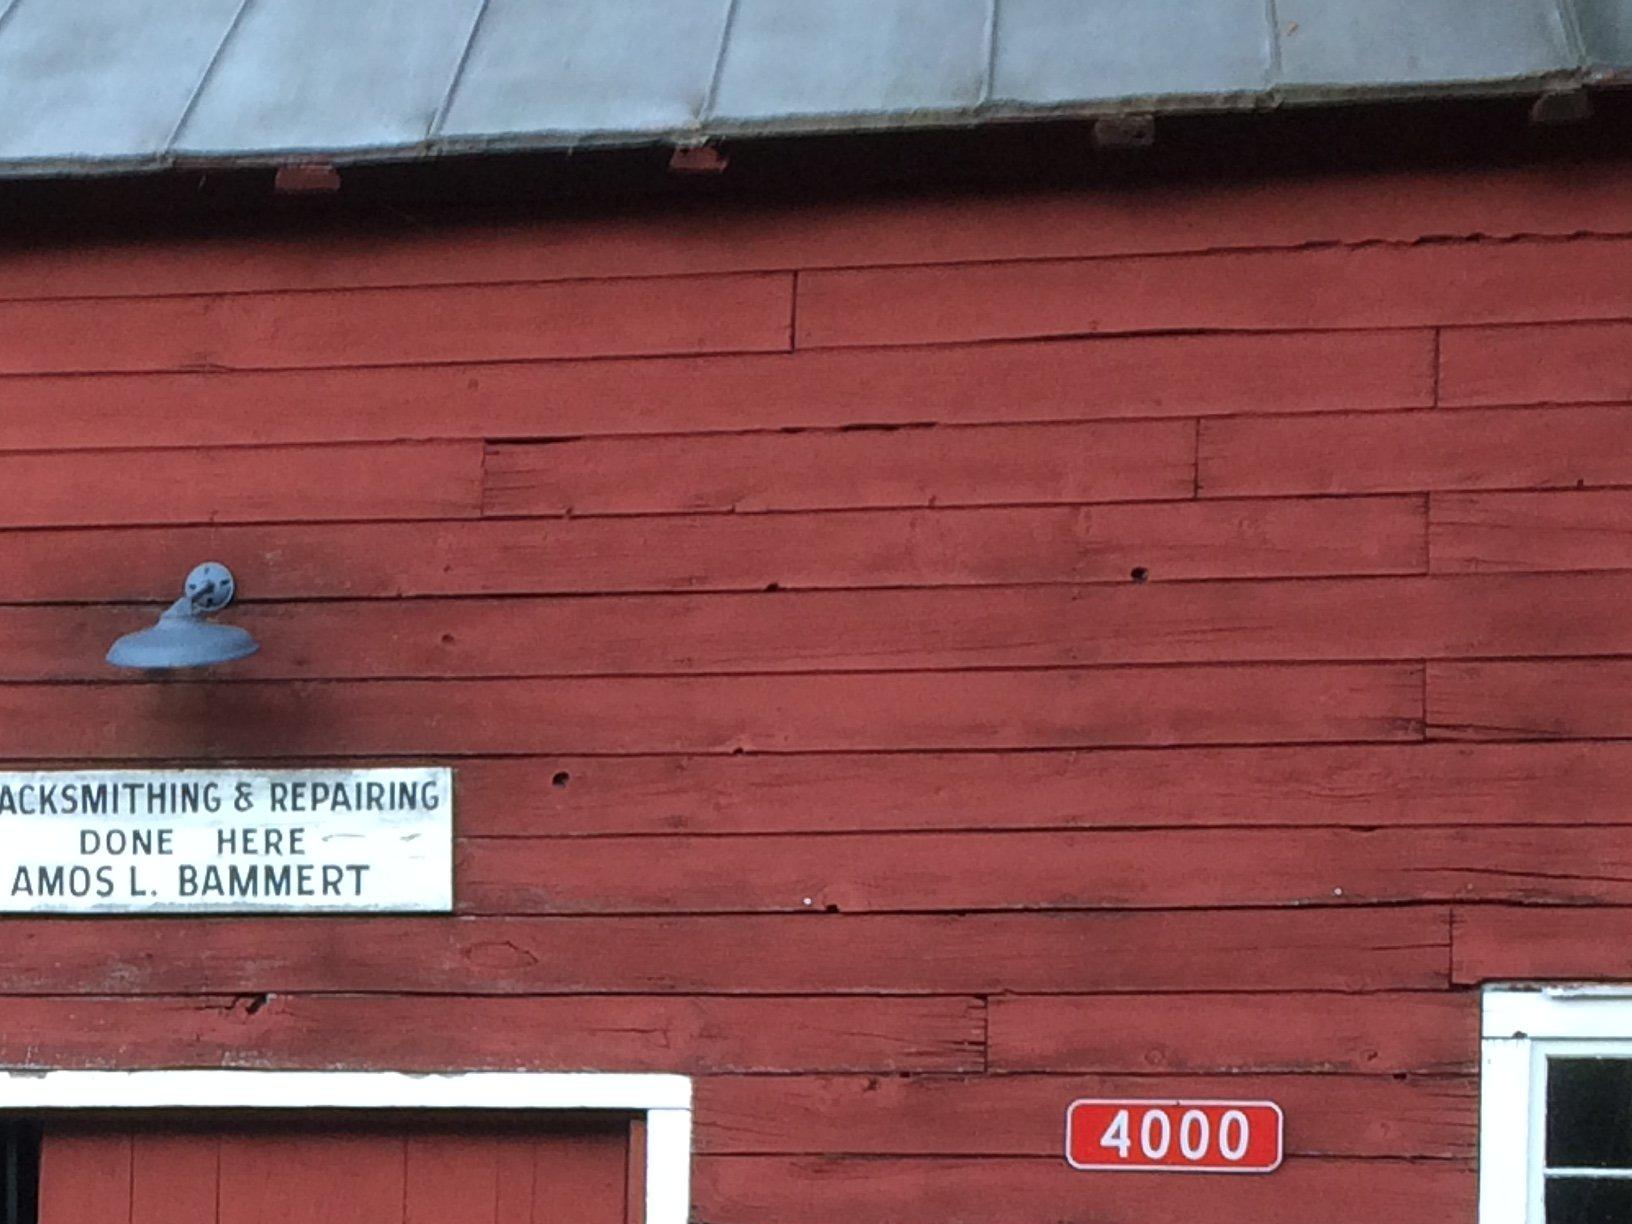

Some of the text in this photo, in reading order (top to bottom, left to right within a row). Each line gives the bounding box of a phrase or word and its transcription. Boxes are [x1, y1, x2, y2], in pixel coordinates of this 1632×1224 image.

[234, 781, 256, 813] &
[269, 779, 440, 812] REPAIRING
[80, 827, 306, 856] DONE HERE
[11, 864, 371, 898] AMOS L. BAMMERT
[1100, 1109, 1250, 1161] 4000
